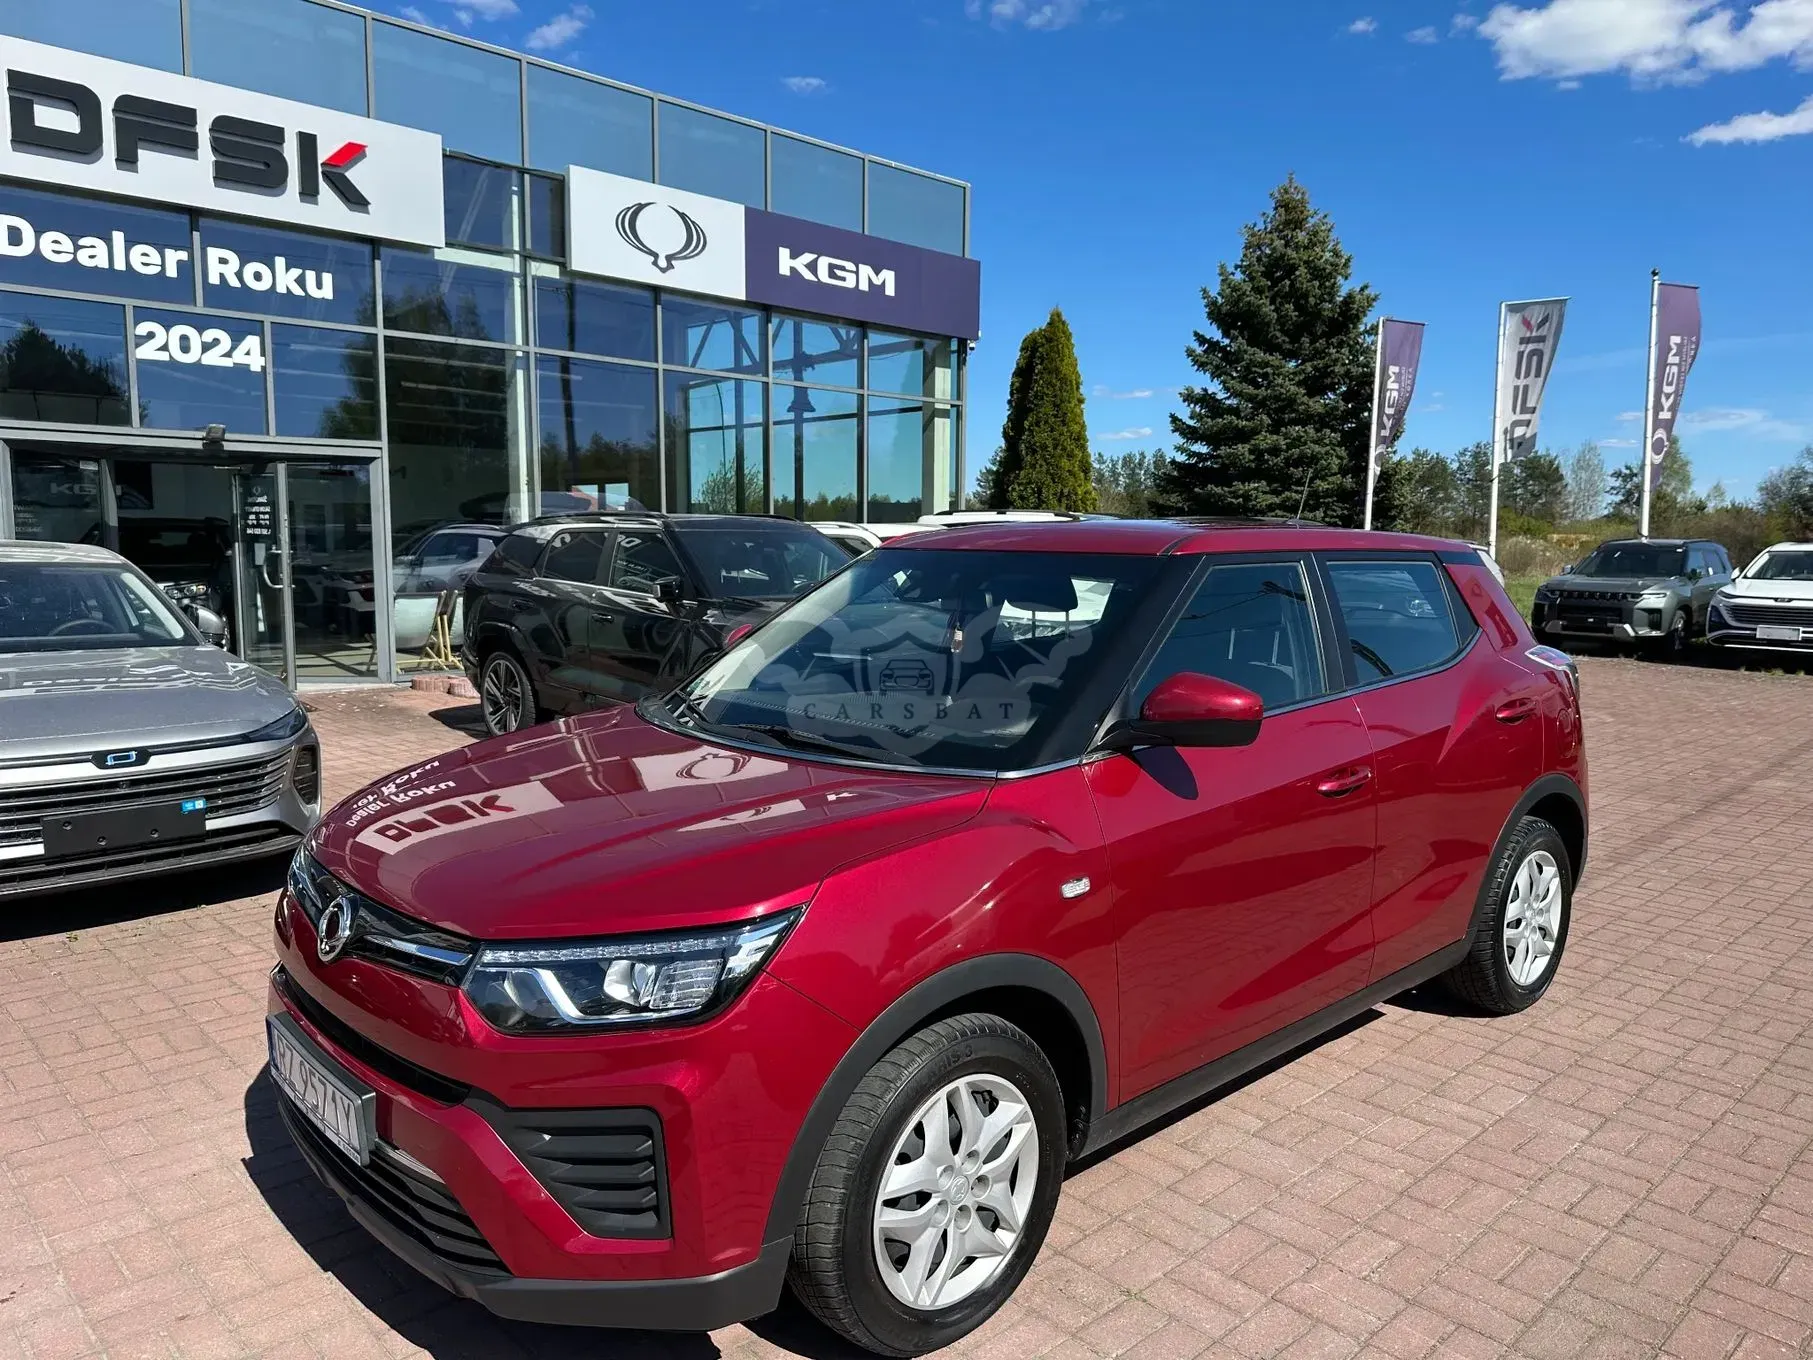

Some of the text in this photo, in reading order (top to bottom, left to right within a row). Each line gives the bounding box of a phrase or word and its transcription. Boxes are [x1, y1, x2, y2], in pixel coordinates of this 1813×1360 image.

[7, 68, 370, 207] DFSK
[0, 213, 334, 301] Dealer Roku
[778, 246, 896, 297] KGM
[134, 321, 266, 373] 2024
[1658, 335, 1682, 420] KGM
[1380, 365, 1400, 437] KGM
